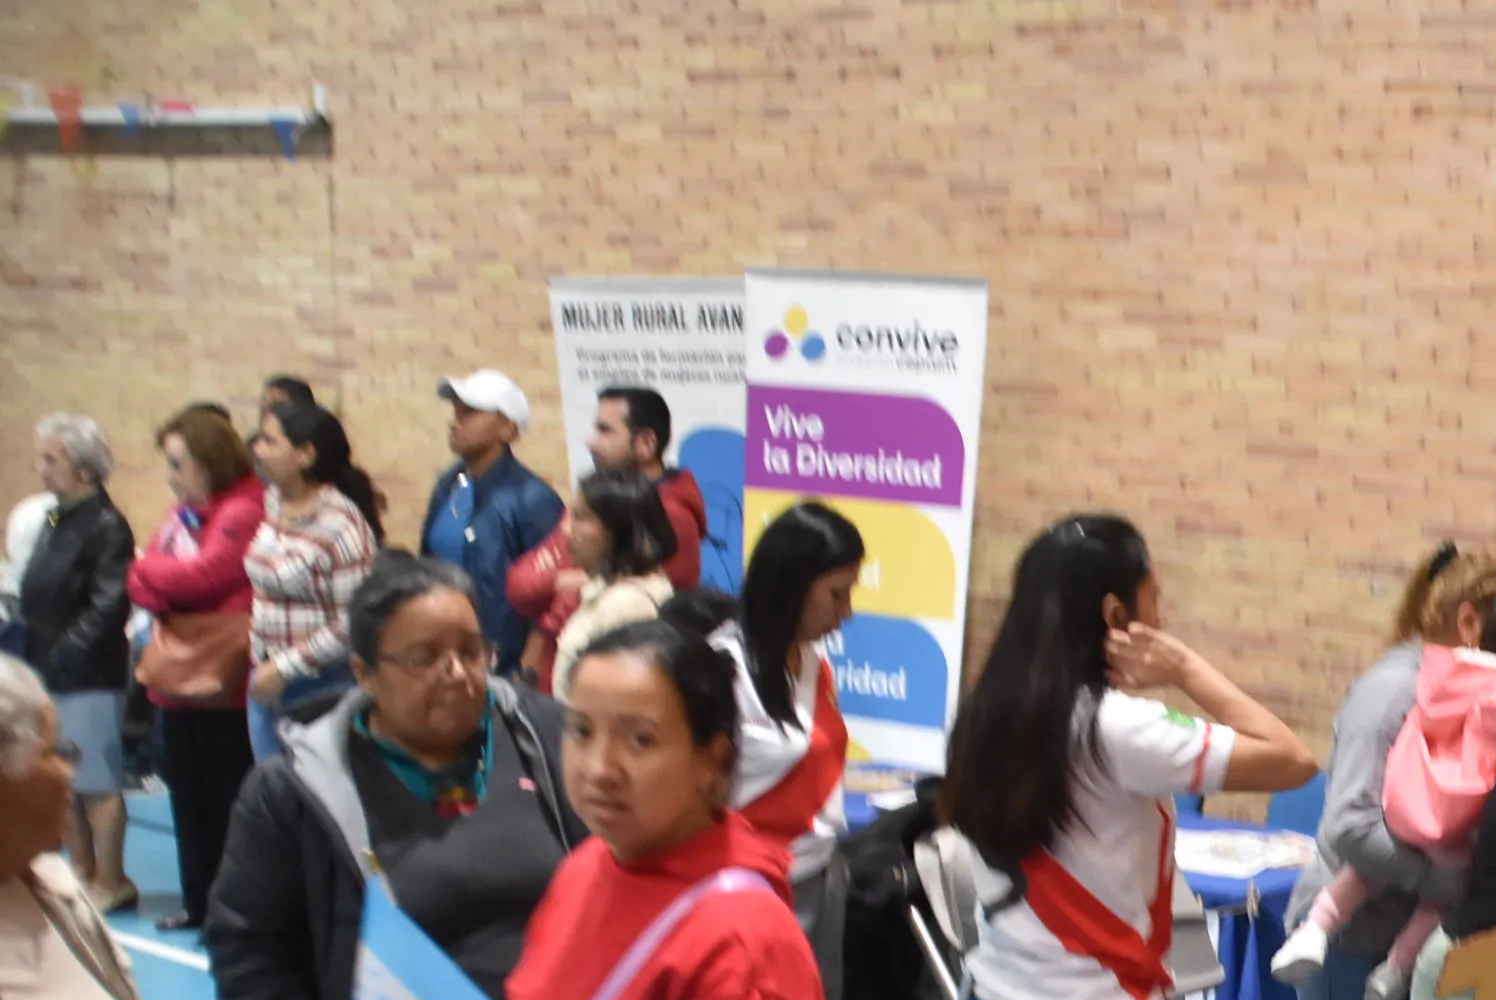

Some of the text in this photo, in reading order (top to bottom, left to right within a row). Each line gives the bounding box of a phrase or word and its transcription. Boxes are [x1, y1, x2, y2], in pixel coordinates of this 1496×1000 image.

[562, 302, 626, 333] MUJER
[631, 302, 688, 333] RURAL
[835, 318, 959, 354] convive
[763, 402, 825, 442] Vive
[763, 437, 942, 490] la Diversidad
[835, 658, 907, 701] ridad
